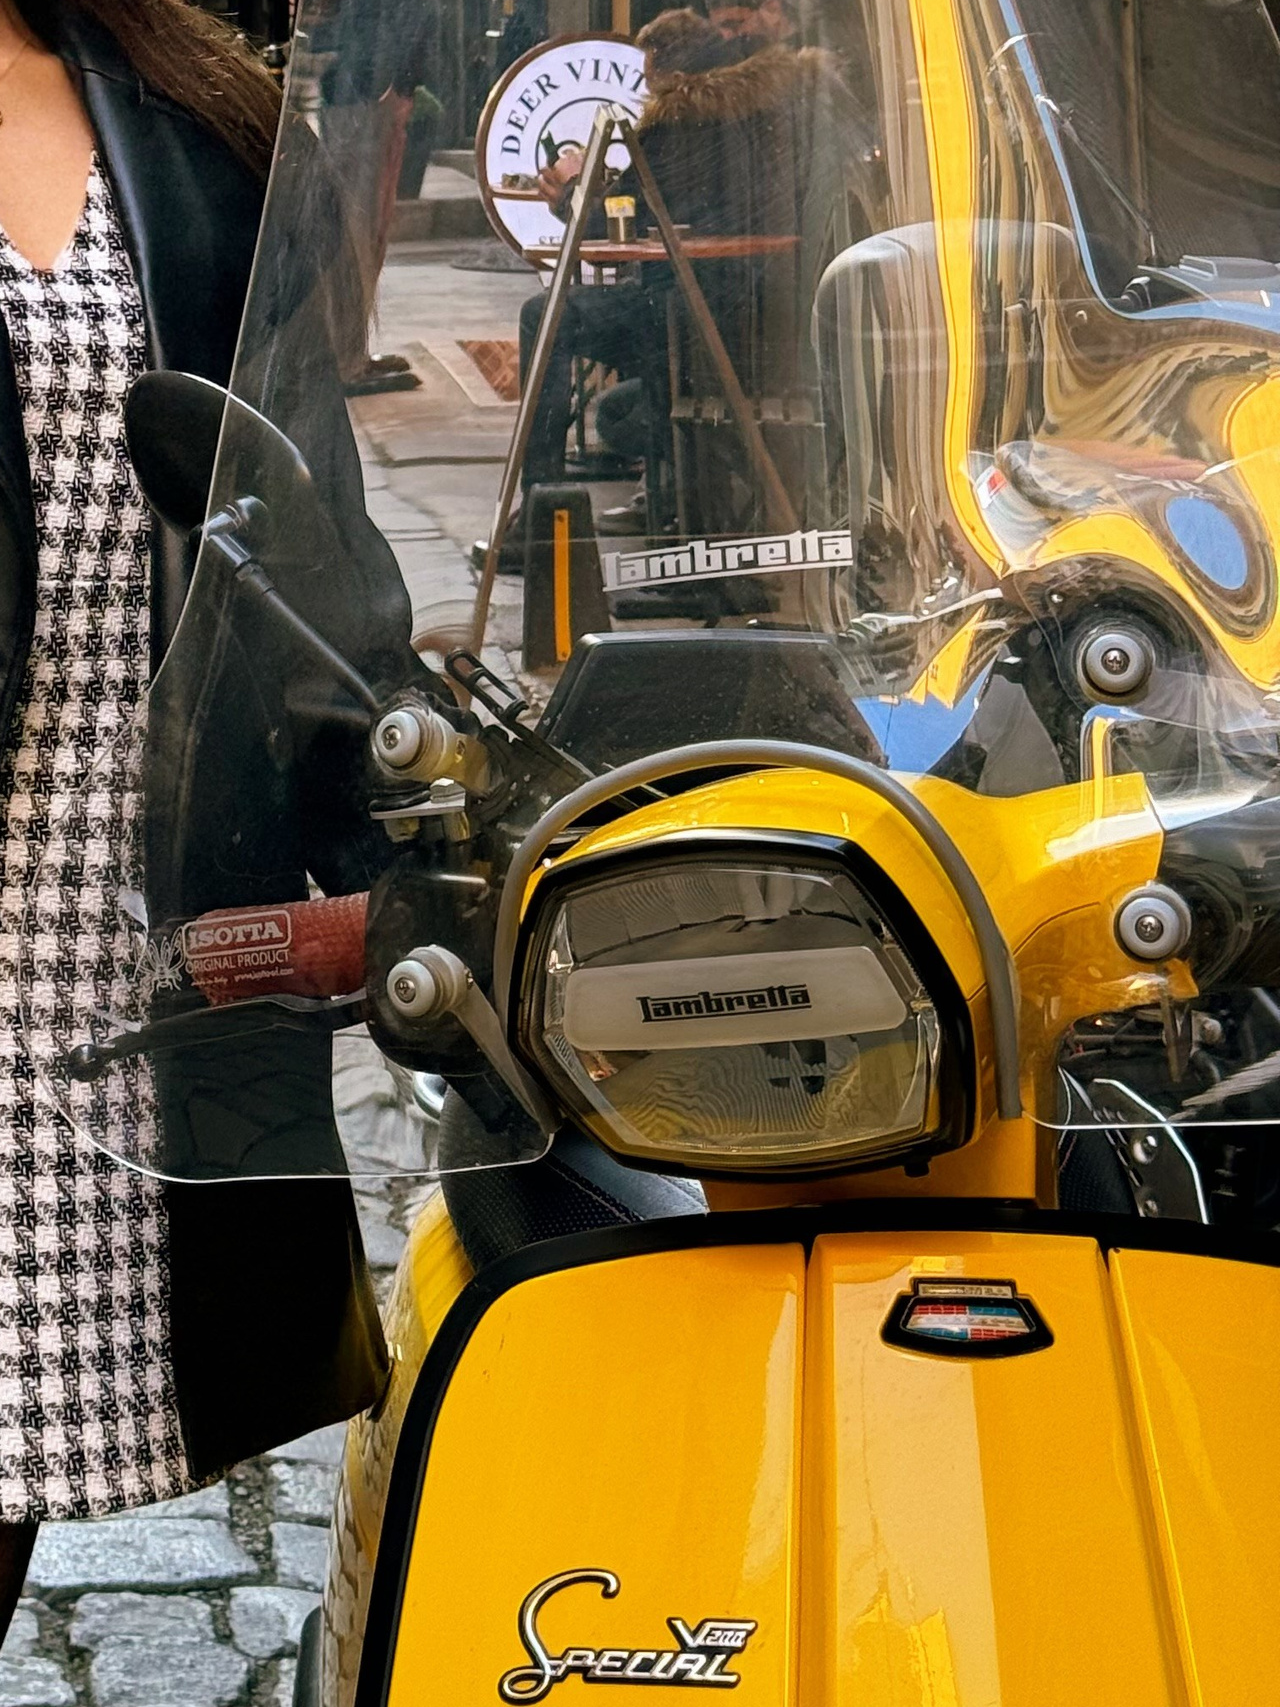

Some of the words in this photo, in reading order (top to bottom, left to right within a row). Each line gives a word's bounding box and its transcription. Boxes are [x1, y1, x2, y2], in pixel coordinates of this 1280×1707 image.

[501, 72, 561, 155] DEER
[564, 58, 646, 94] VINT
[601, 529, 853, 592] Lambretta
[187, 920, 284, 949] ISOTTA
[185, 953, 236, 975] ORIGINAL
[237, 948, 290, 969] PRODUCT
[636, 984, 812, 1023] Lambretta
[668, 1618, 757, 1648] V200
